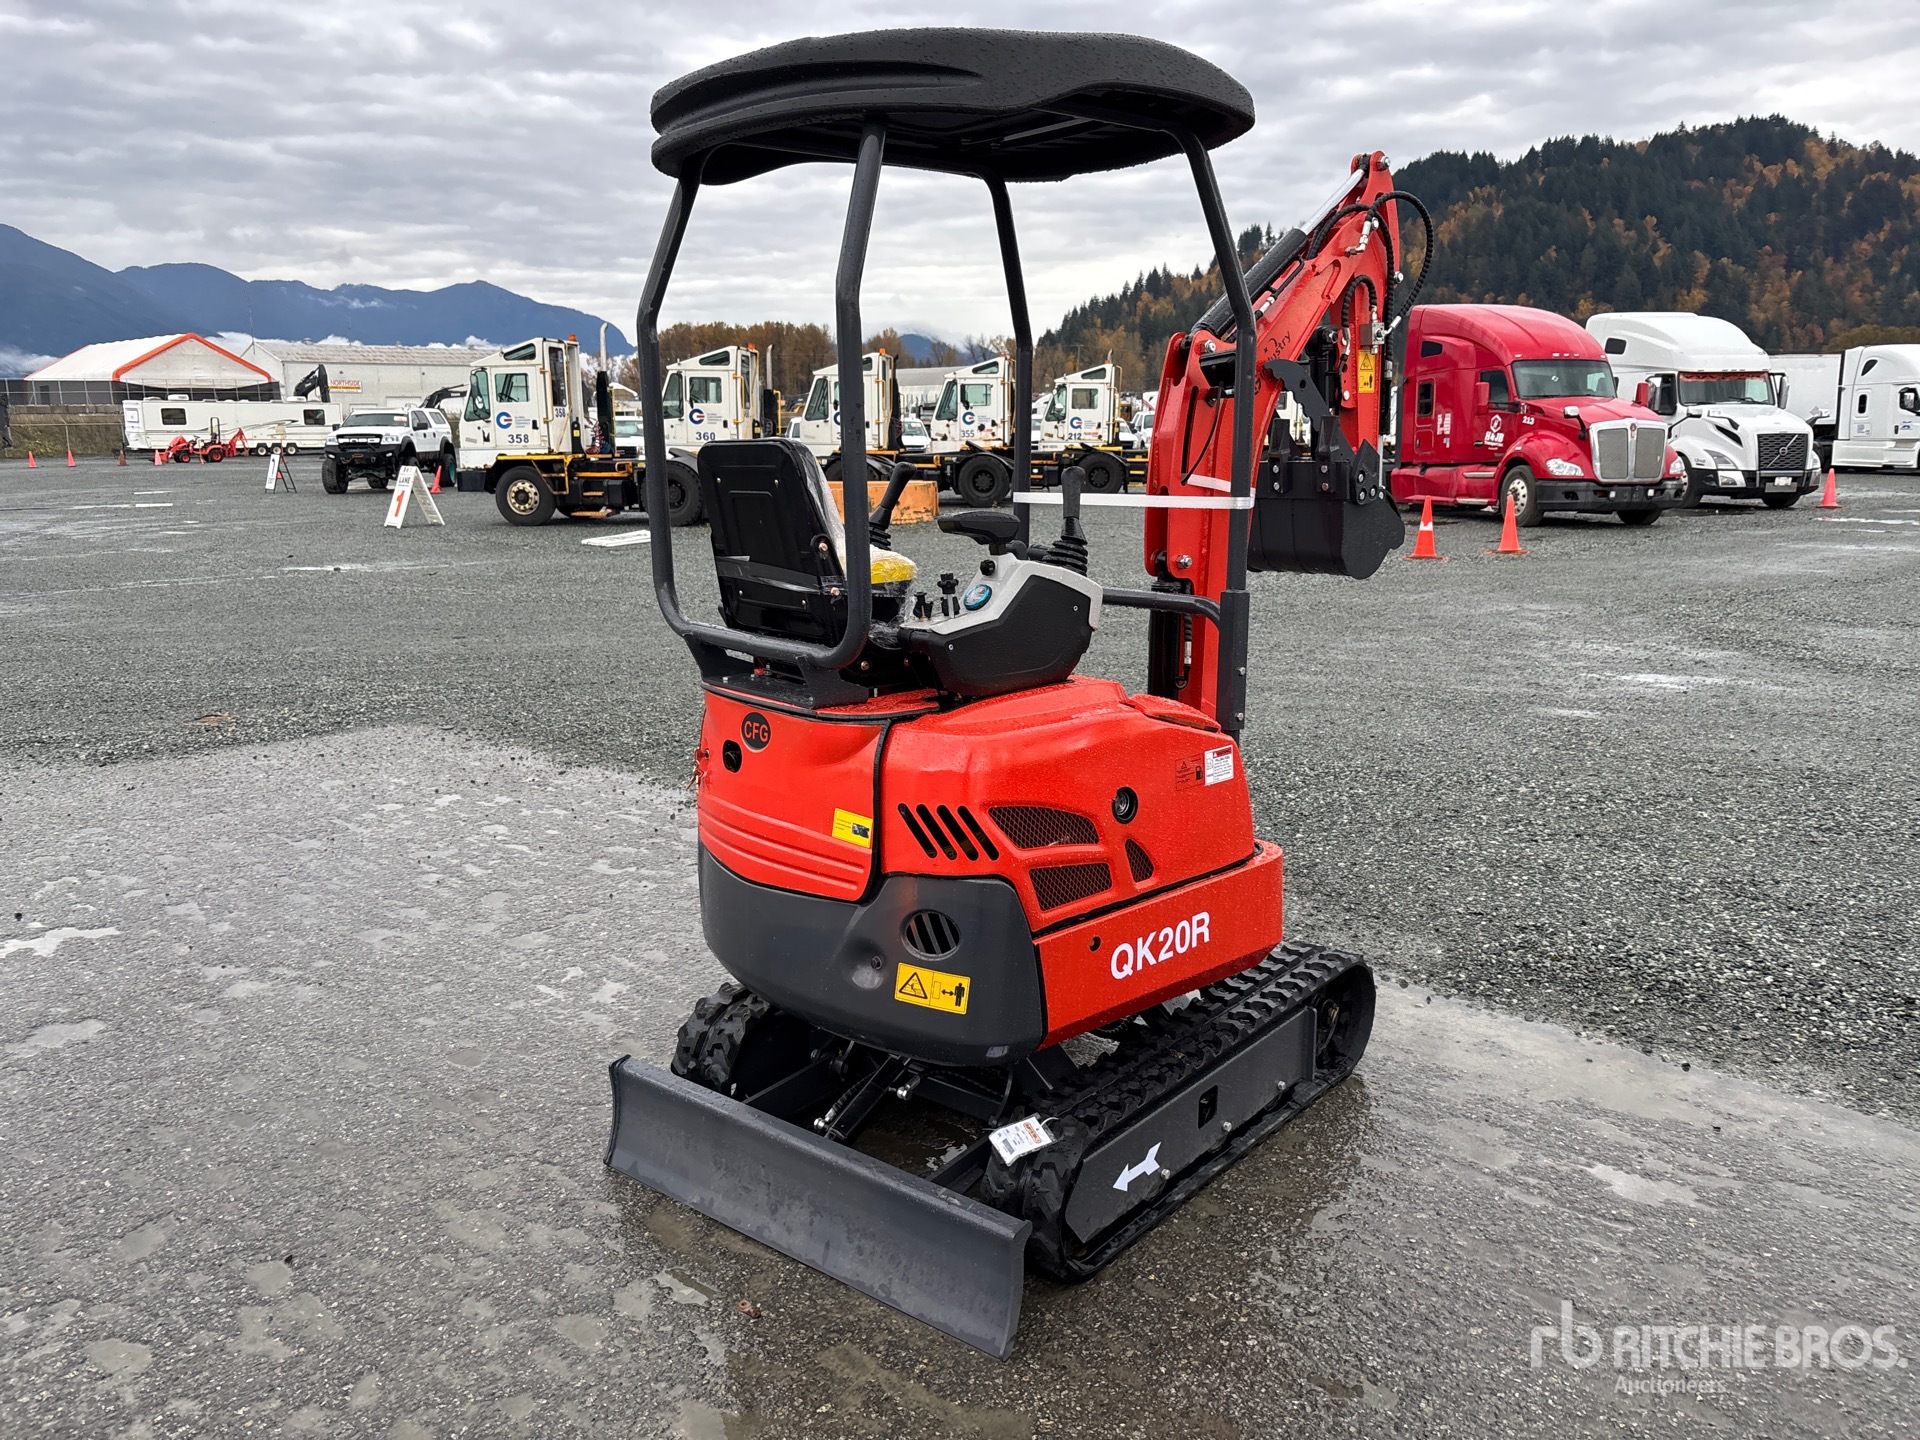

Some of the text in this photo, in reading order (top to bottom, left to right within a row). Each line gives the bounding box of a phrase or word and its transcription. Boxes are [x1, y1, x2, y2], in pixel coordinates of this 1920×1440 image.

[555, 408, 566, 417] 358
[1522, 416, 1535, 425] 213
[695, 432, 716, 441] 360
[961, 429, 975, 438] 355
[1068, 432, 1082, 440] 212
[508, 434, 529, 443] 358
[394, 489, 406, 518] 1
[744, 720, 769, 742] CFG
[1110, 911, 1210, 980] QK20R
